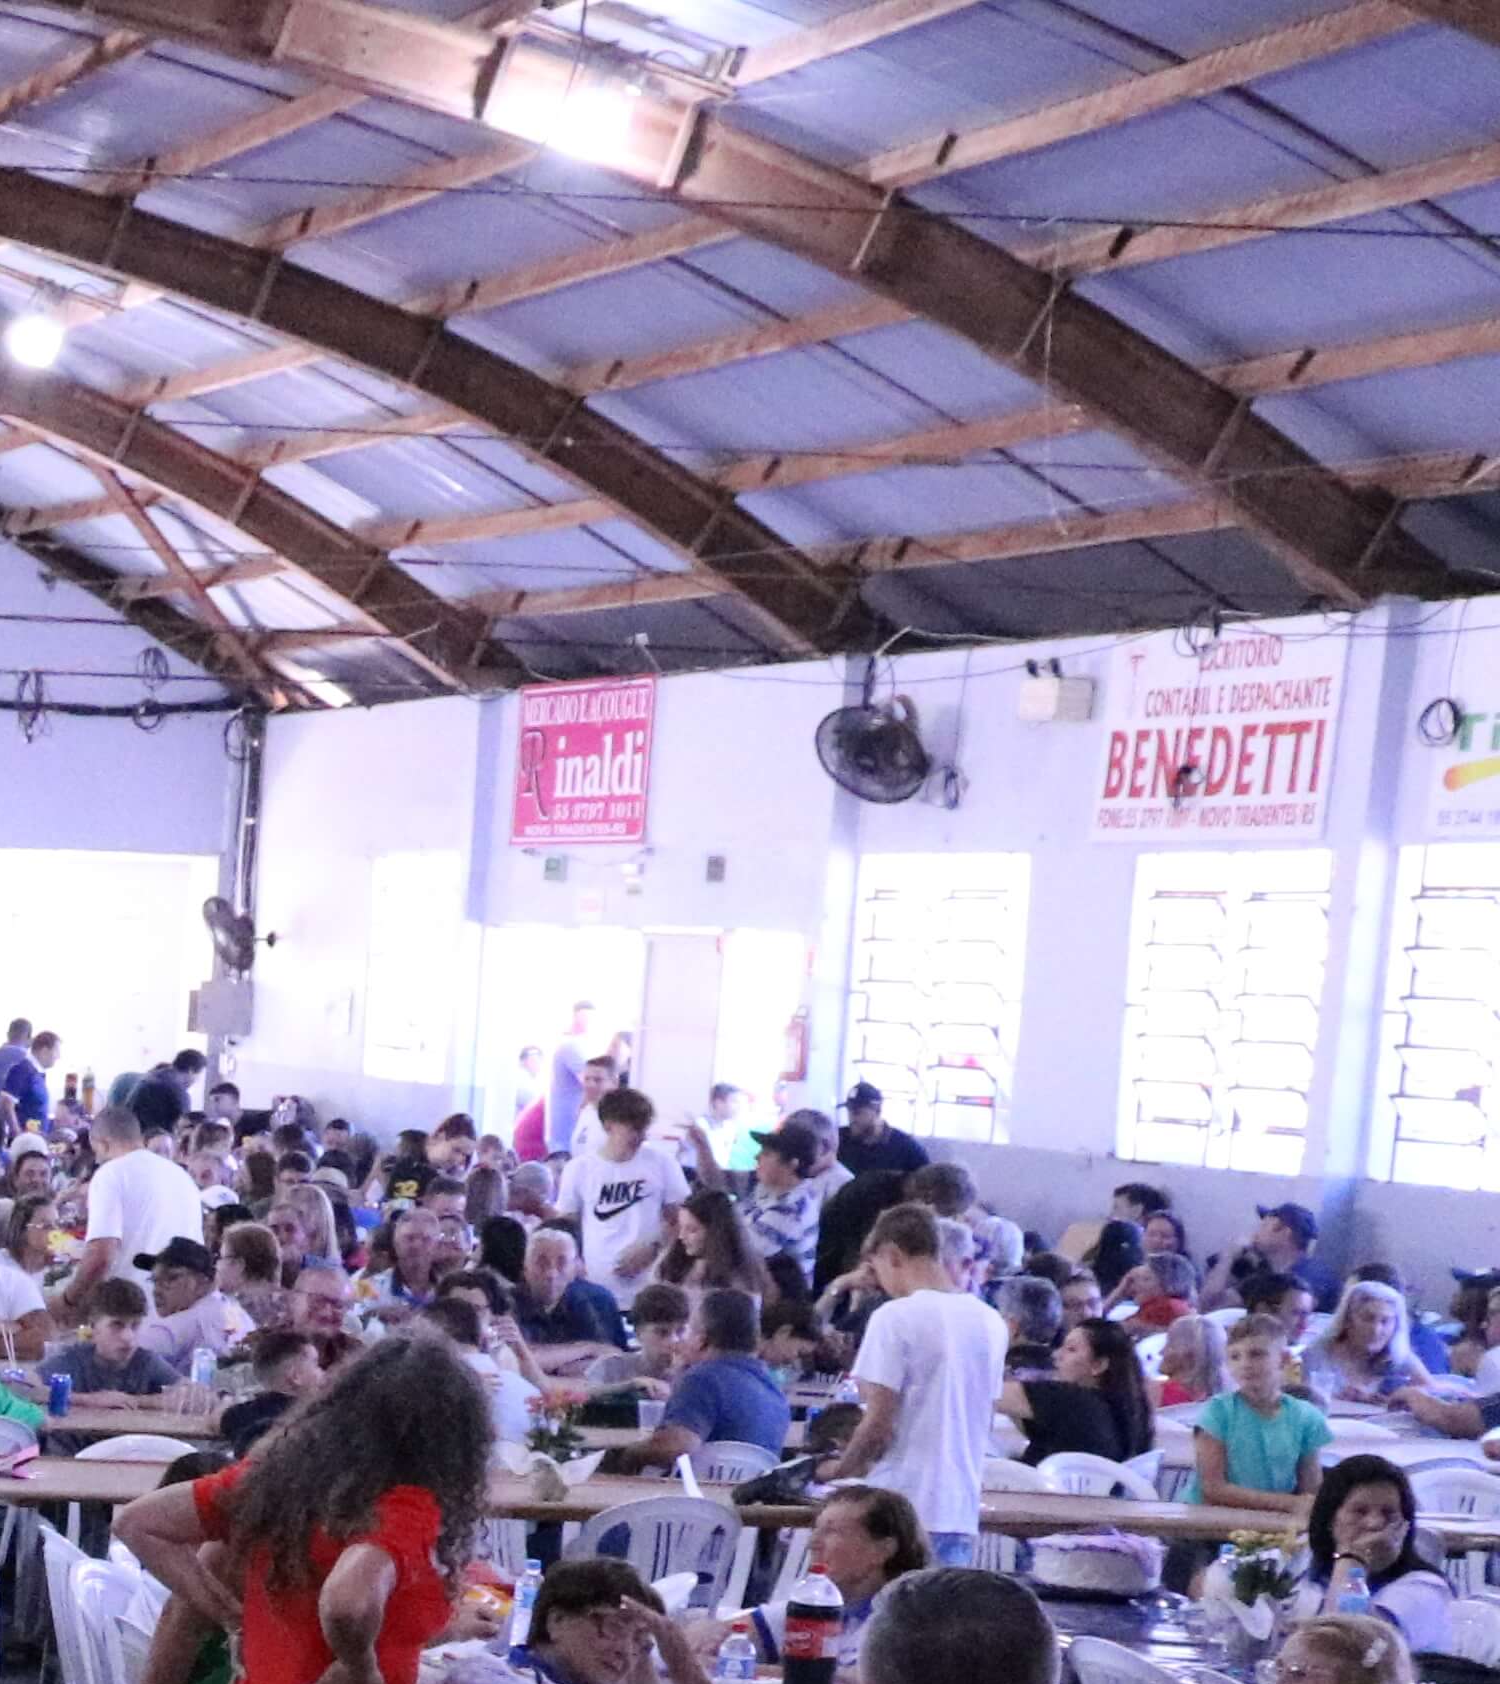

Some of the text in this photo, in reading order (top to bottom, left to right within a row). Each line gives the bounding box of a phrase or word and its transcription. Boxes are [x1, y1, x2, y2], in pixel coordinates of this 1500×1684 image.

[1216, 684, 1226, 714] E
[1229, 676, 1333, 714] DESPACHANTE
[1102, 719, 1327, 799] BENEDETTI
[598, 1179, 647, 1205] NIKE
